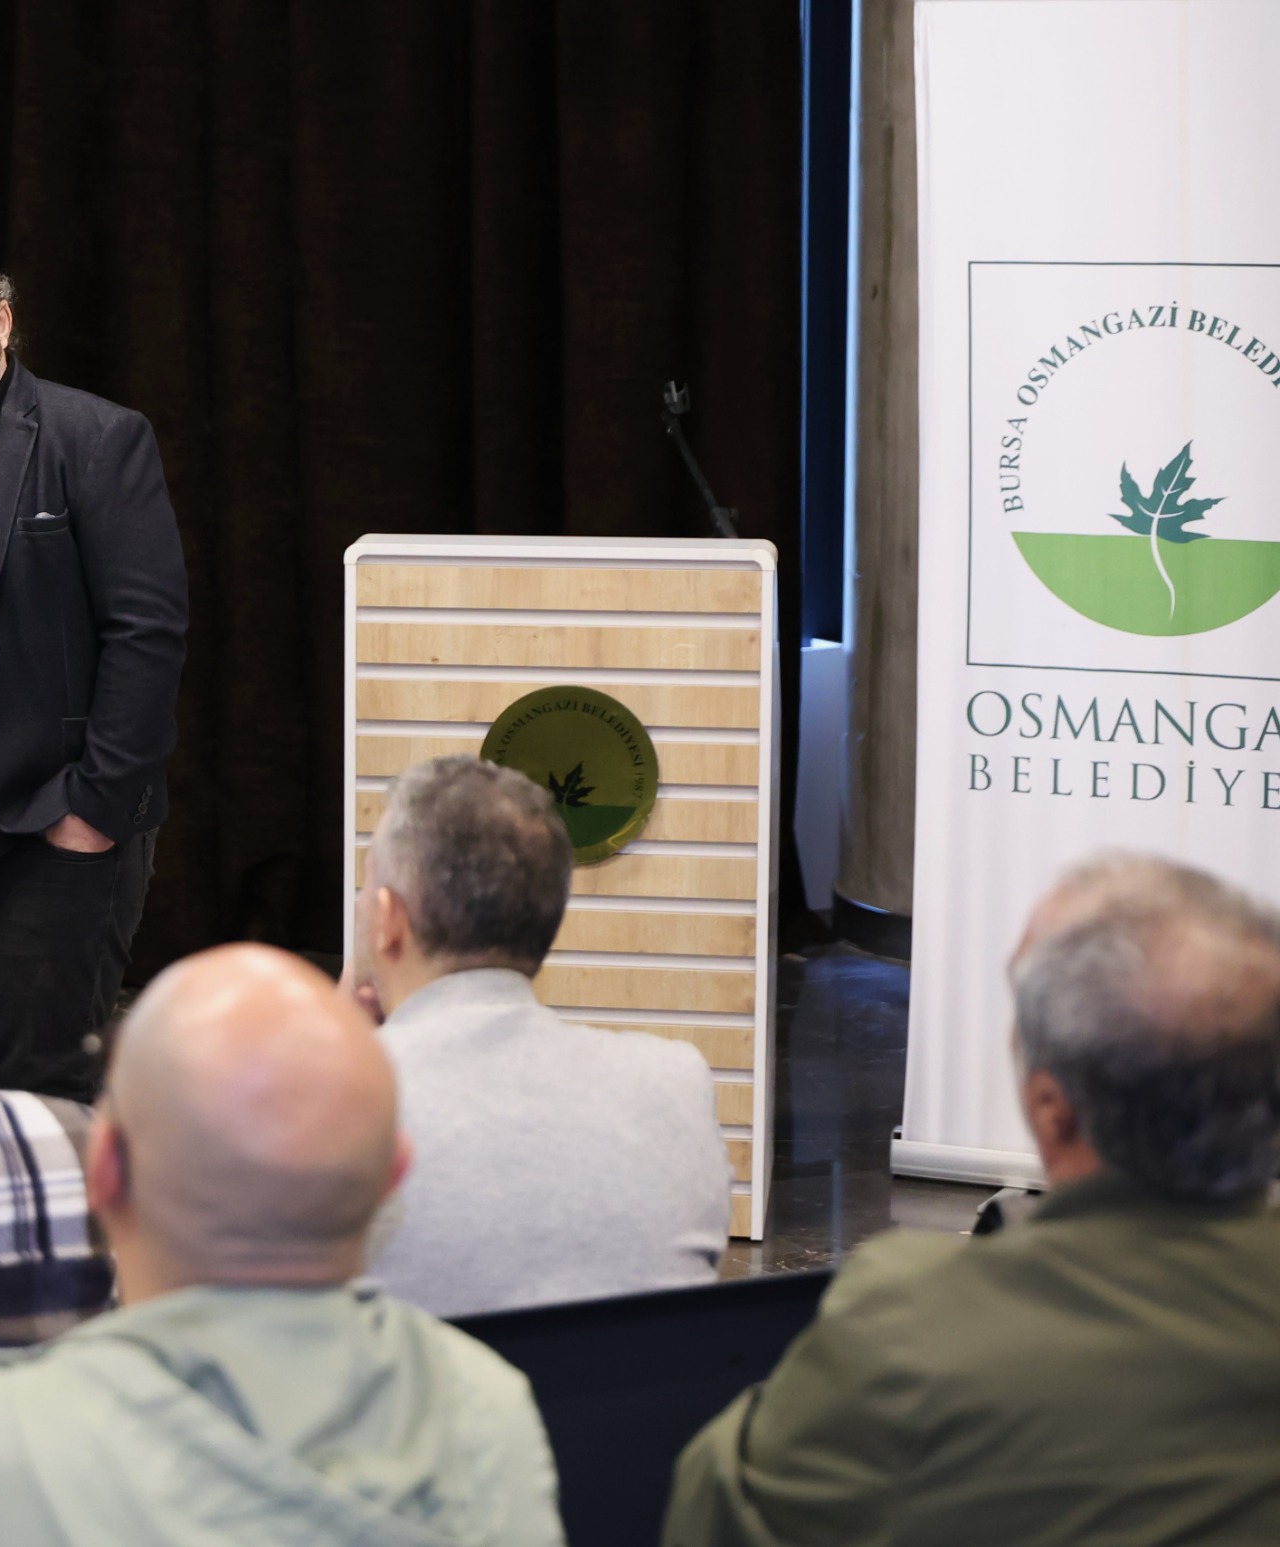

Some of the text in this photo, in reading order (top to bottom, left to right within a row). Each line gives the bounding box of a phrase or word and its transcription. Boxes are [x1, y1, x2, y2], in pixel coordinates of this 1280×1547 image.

[999, 416, 1029, 514] BURSA
[1016, 300, 1179, 406] OSMANGAZİ
[966, 690, 1280, 751] OSMANGA
[968, 754, 1280, 810] BELEDİYE
